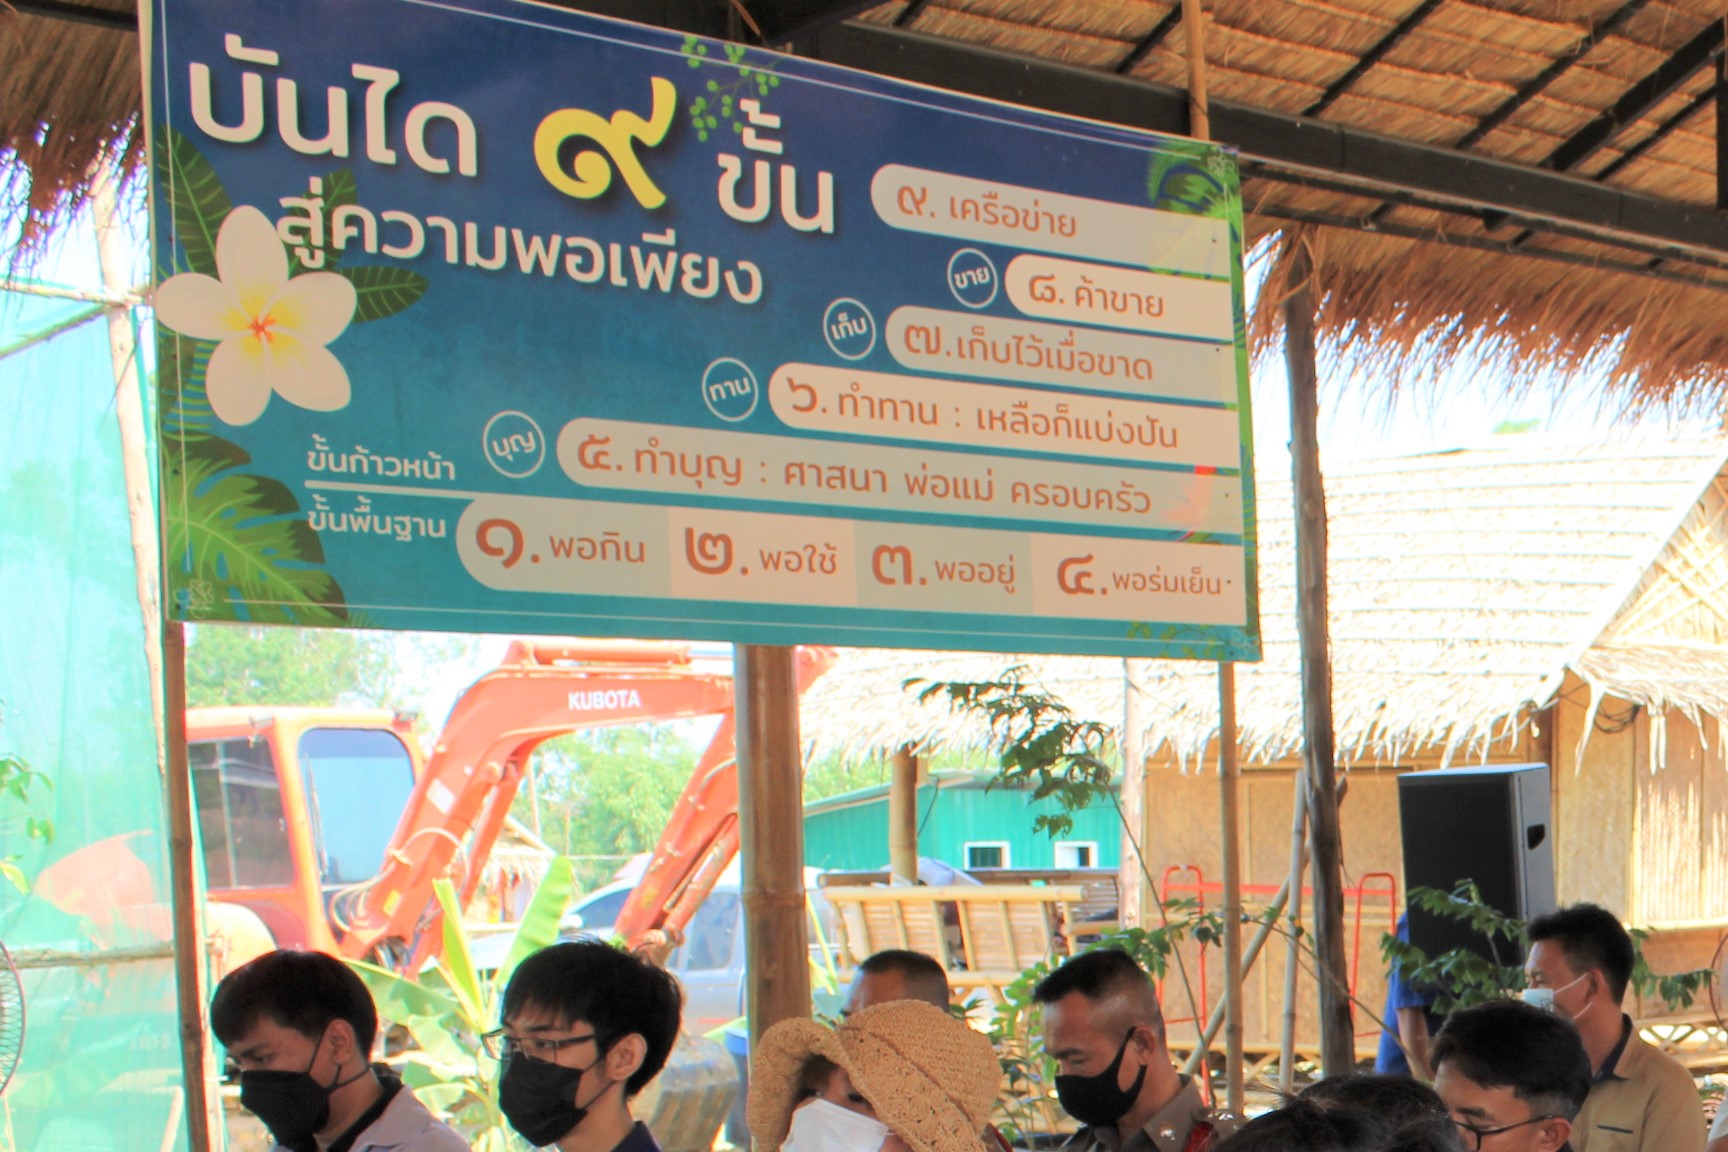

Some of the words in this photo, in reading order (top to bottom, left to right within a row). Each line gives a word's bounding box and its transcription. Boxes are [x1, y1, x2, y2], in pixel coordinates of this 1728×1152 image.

[189, 33, 478, 177] บันได
[533, 75, 678, 210] ๙
[716, 97, 835, 235] ขั้น
[949, 190, 1078, 238] เครือข่าย
[275, 175, 764, 305] สู่ความพอเพียง
[953, 265, 992, 290] ขาย
[1075, 275, 1164, 318] ค้าขาย
[831, 314, 869, 341] เก็บ
[708, 374, 751, 401] ทาน
[838, 382, 939, 426] ทำทาน
[976, 400, 1179, 448] เหลือก็แบ่งปัน
[306, 433, 456, 481] ขั้นก้าวหน้า
[492, 431, 537, 461] บุญ
[635, 437, 742, 489] ทำบุญ
[783, 455, 888, 494] ศาสนา
[904, 463, 994, 502] พ่อแม่
[1010, 479, 1151, 514] ครอบครัว
[307, 493, 447, 542] ขั้นพื้นฐาน
[549, 530, 646, 564] พอกิน
[758, 543, 838, 576] พอใช้
[935, 554, 1016, 595] พออยู่
[1112, 565, 1222, 596] พอร่มเย็น
[568, 689, 641, 711] KUBOTA
